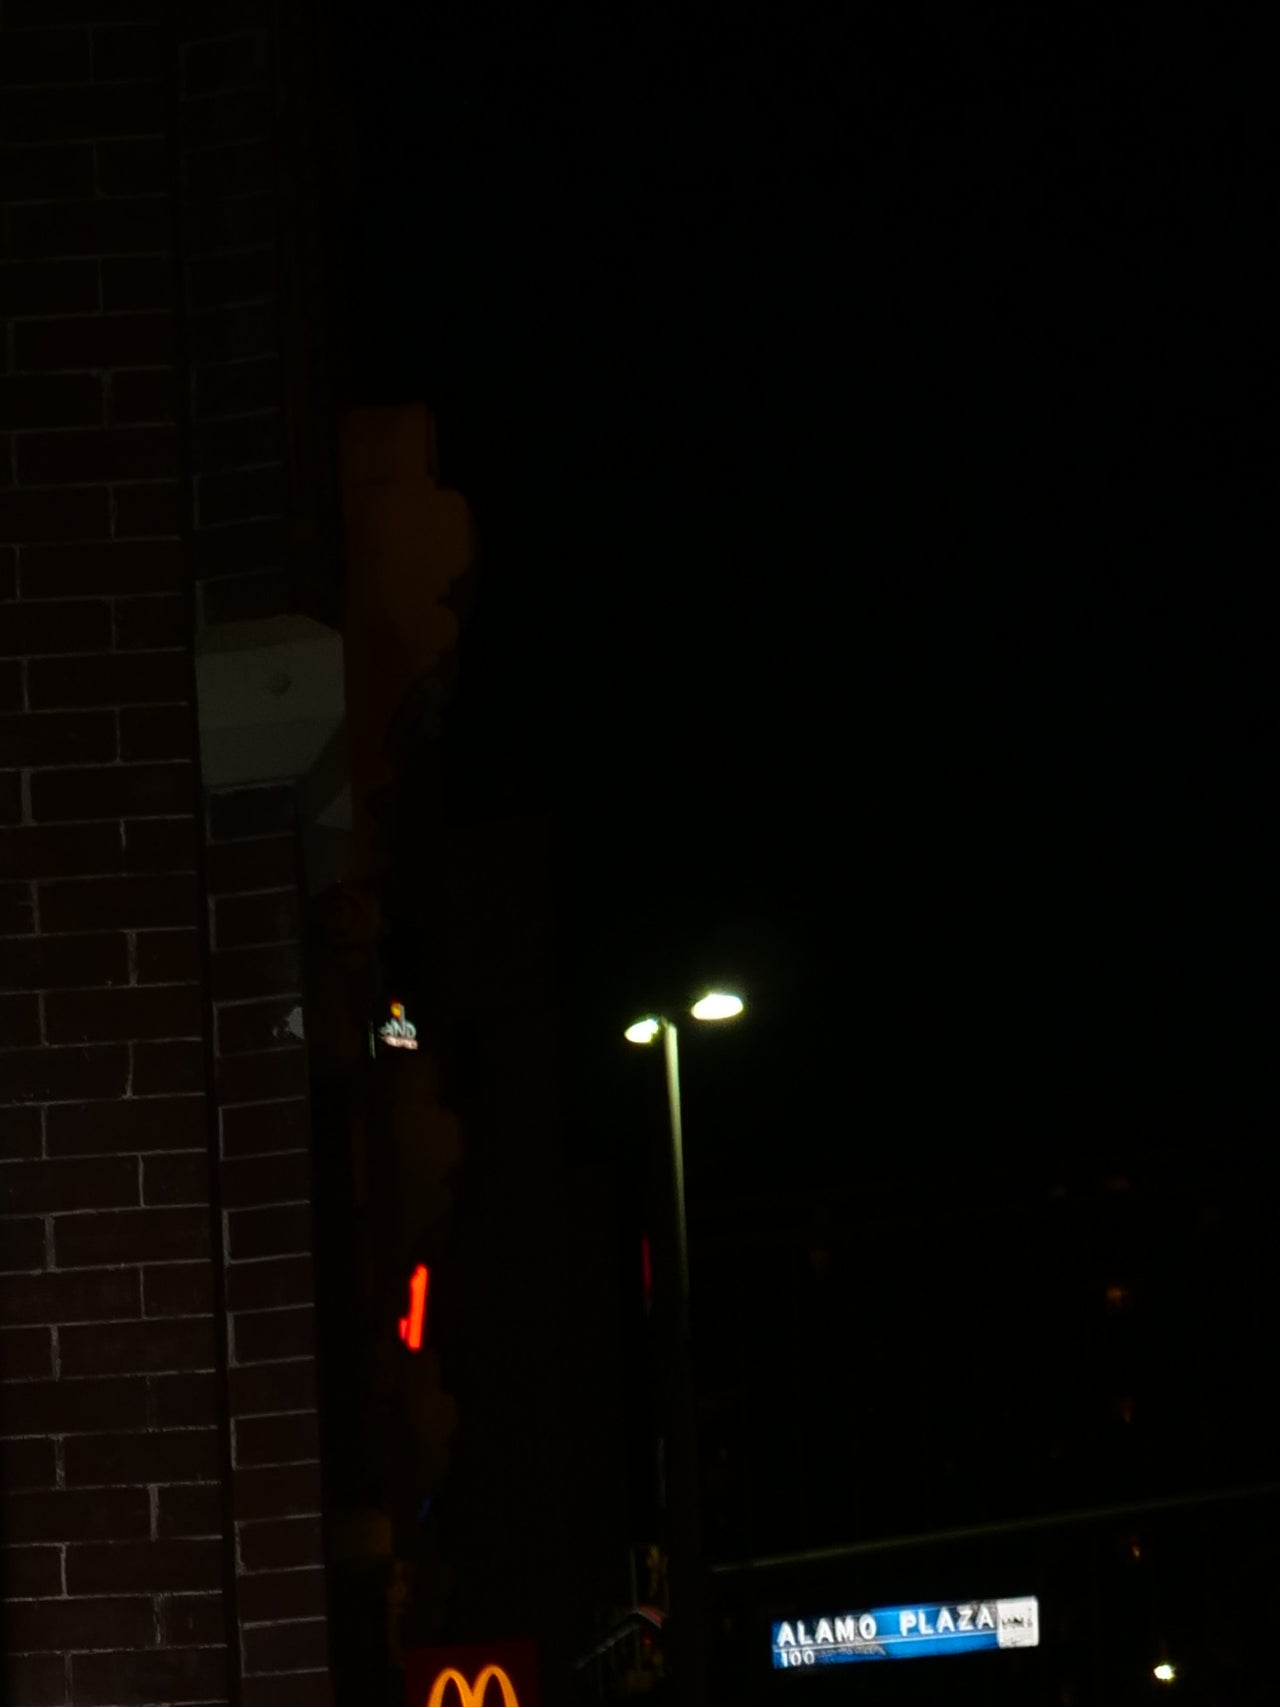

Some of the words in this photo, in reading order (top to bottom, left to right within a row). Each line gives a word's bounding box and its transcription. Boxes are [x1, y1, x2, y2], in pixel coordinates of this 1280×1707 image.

[776, 1612, 877, 1648] ALAMO
[899, 1606, 996, 1637] PLAZA
[778, 1648, 816, 1668] 100
